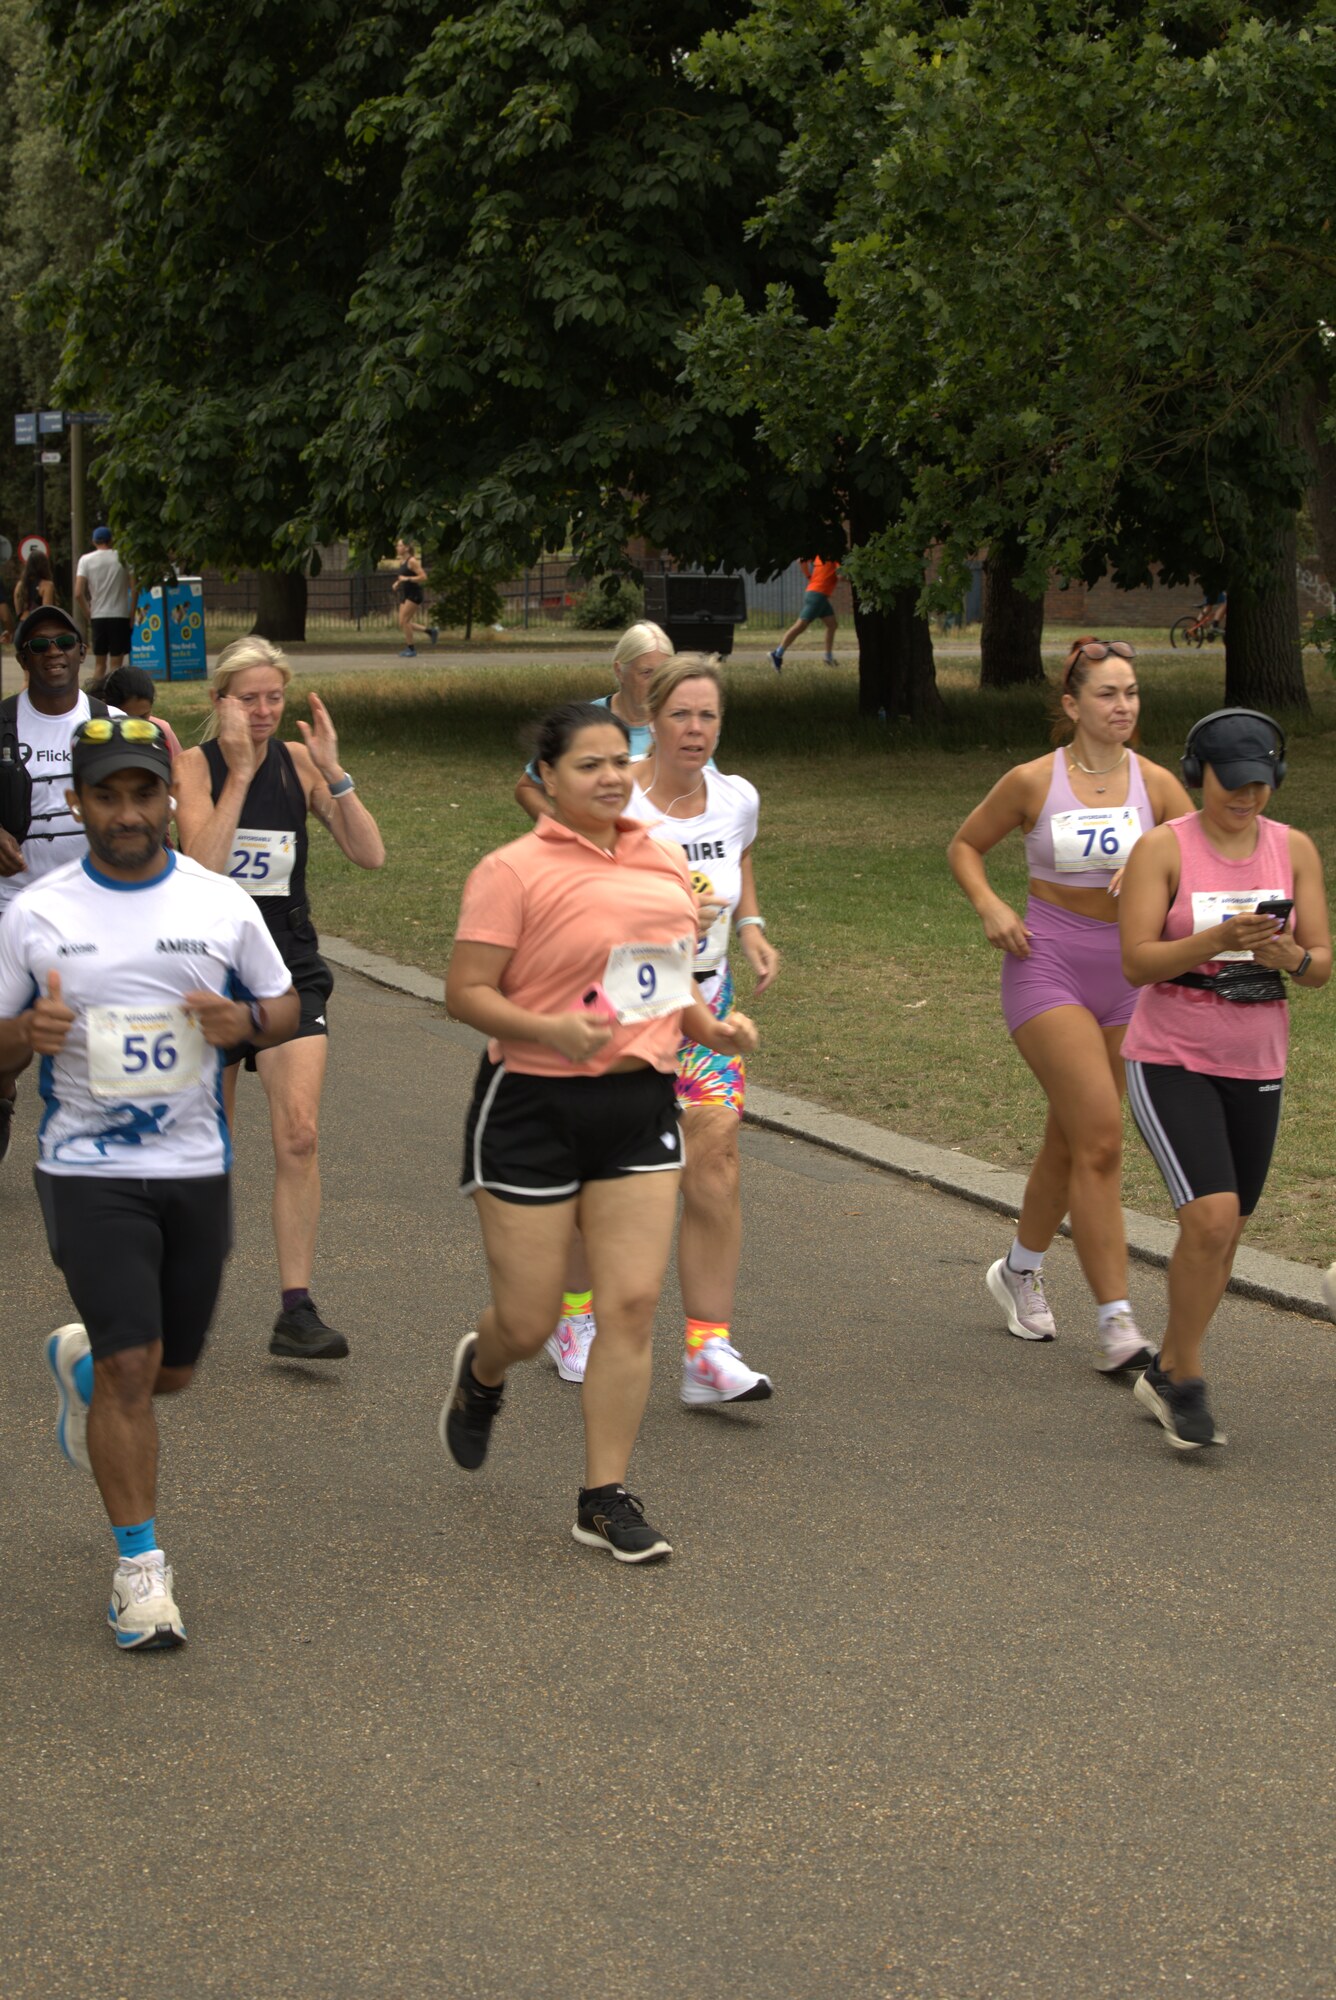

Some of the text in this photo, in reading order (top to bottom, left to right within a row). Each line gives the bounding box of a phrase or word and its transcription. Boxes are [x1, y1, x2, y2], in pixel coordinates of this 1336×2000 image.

[36, 750, 71, 761] Flick
[1077, 827, 1119, 856] 76
[230, 850, 270, 879] 25
[637, 962, 655, 999] 9
[122, 1032, 177, 1073] 56
